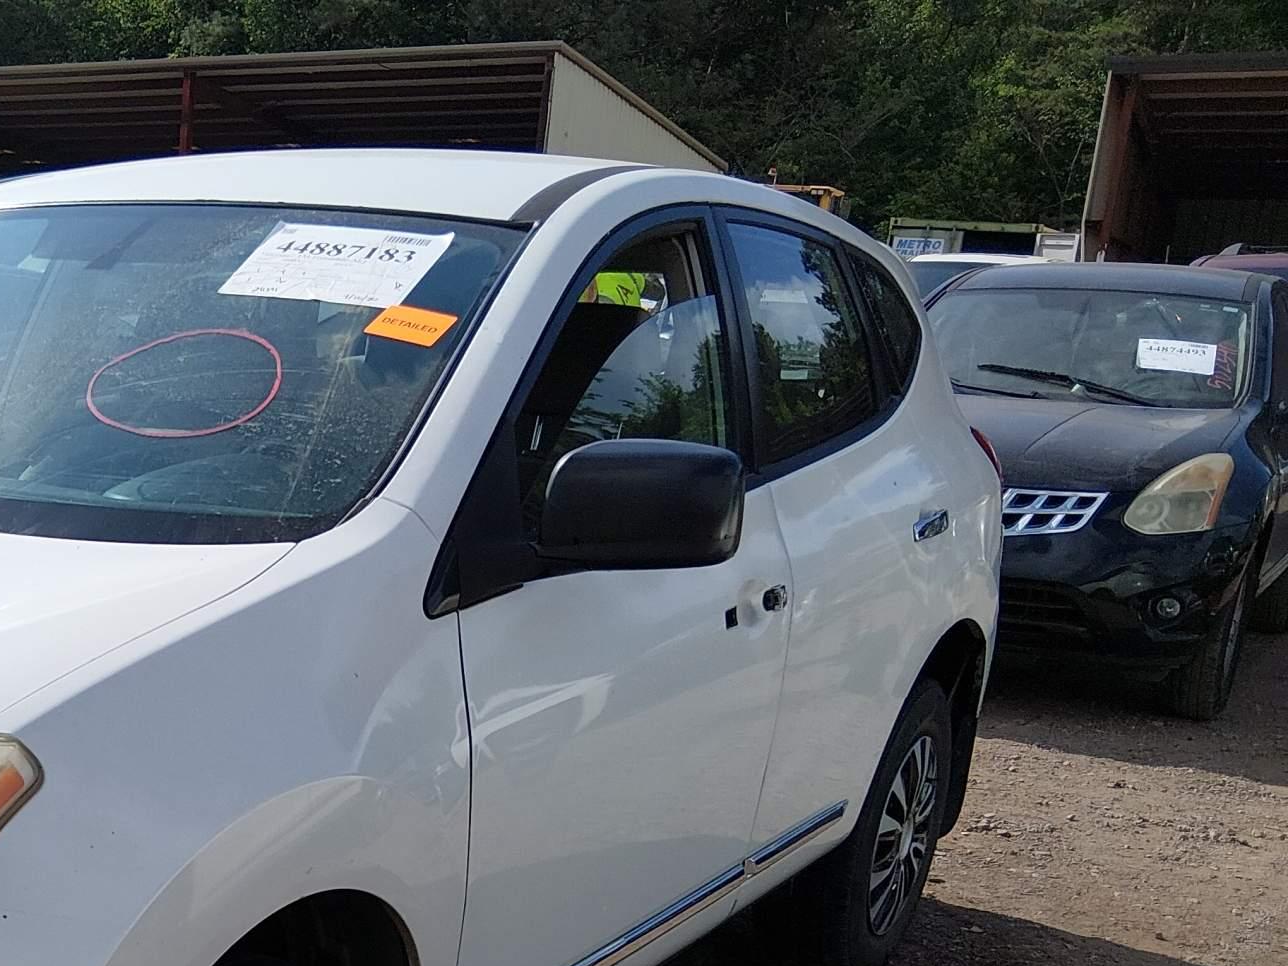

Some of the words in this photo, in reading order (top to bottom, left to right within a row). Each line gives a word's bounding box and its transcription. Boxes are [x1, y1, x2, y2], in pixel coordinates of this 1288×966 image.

[277, 240, 417, 265] 44887183
[896, 239, 942, 250] METRO
[381, 317, 438, 334] DETAILED
